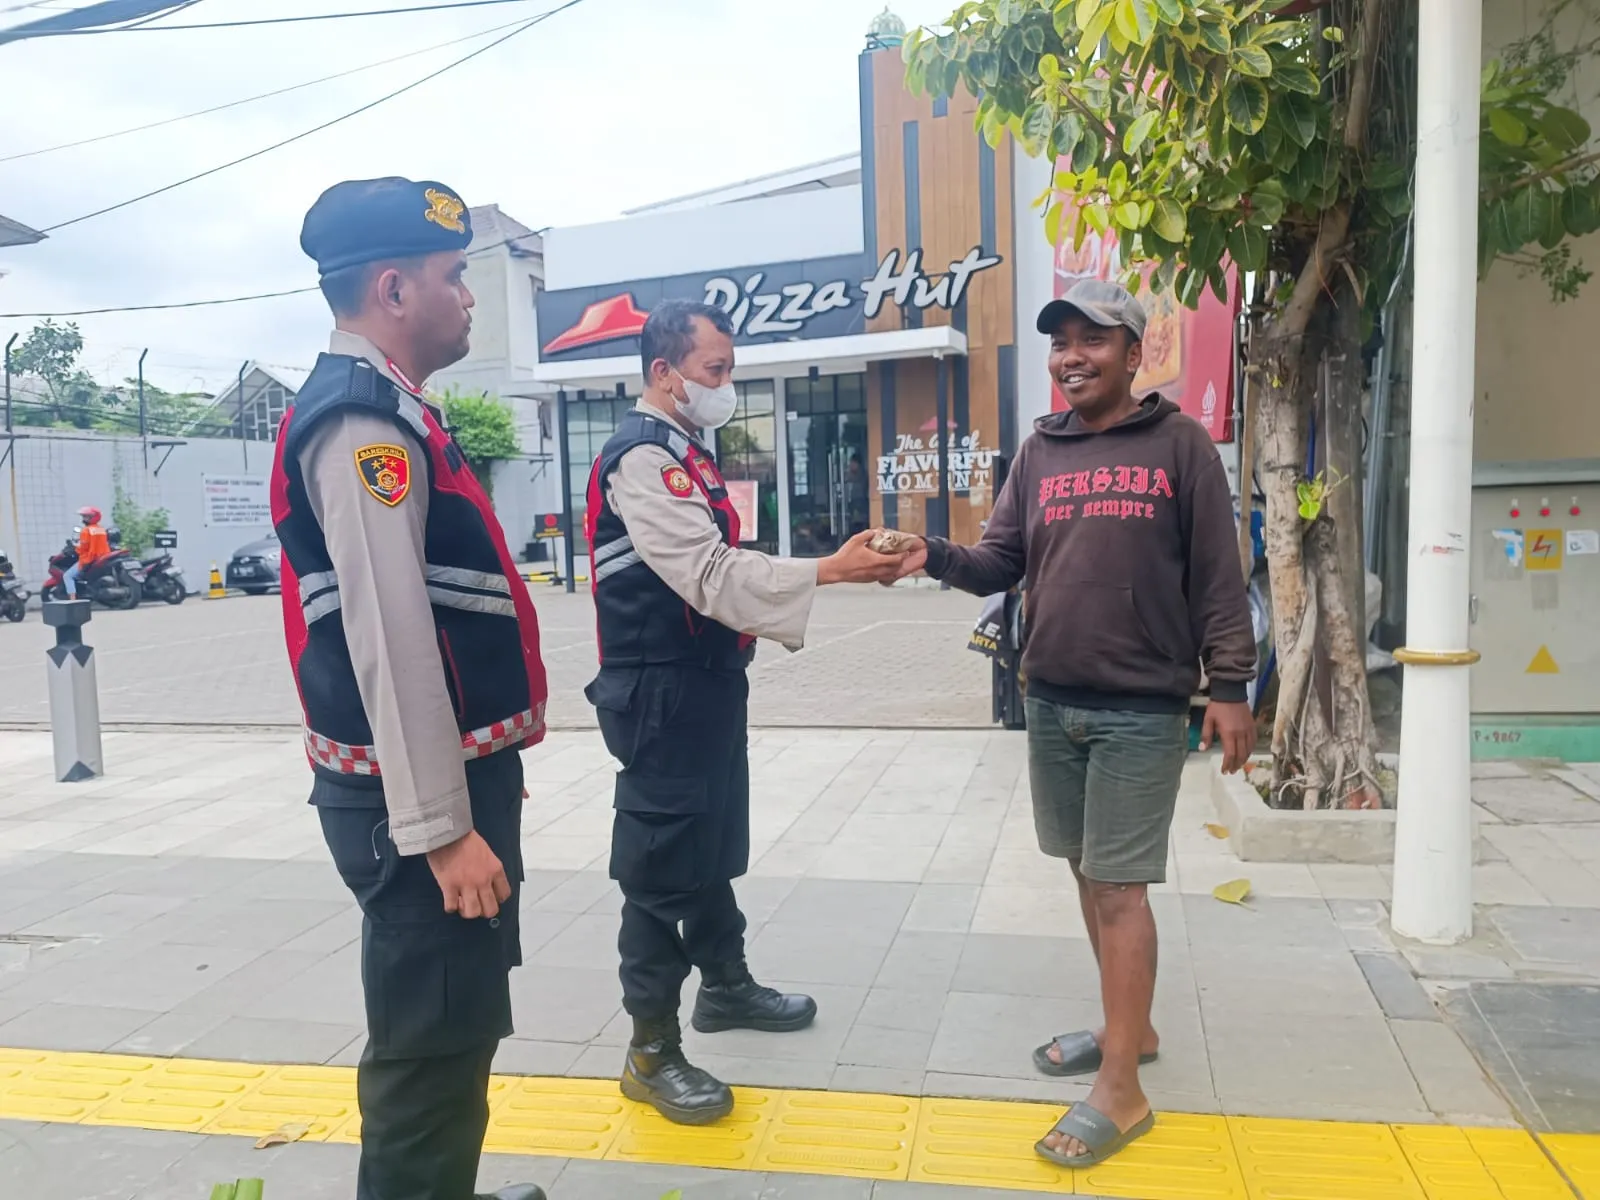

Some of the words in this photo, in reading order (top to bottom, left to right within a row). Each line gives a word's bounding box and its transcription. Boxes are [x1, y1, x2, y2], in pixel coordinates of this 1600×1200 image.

[703, 273, 851, 336] Pizza
[860, 246, 1003, 318] Hut
[893, 433, 924, 455] The
[961, 429, 980, 451] of
[1044, 503, 1075, 526] per
[1082, 499, 1155, 519] sempre
